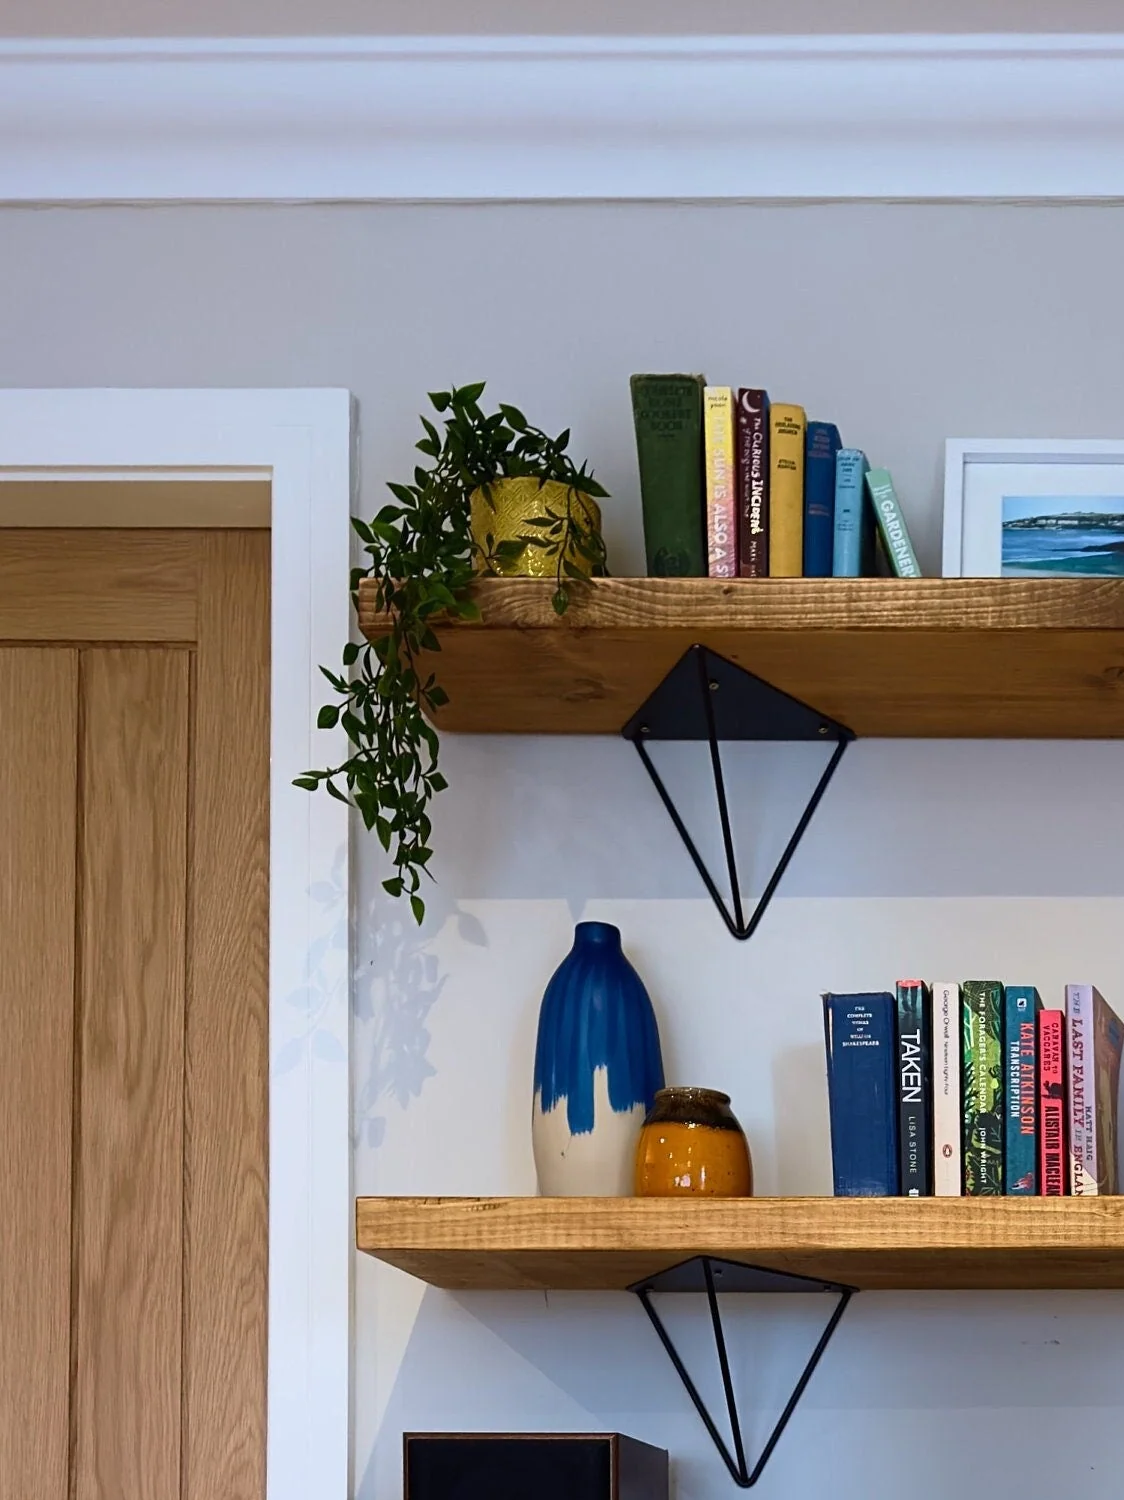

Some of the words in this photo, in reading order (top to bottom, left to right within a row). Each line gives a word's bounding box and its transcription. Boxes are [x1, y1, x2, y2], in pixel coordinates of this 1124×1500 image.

[713, 449, 726, 480] SUN
[714, 485, 726, 498] IS
[714, 504, 727, 544] ALSO
[715, 548, 727, 559] A
[1020, 1023, 1034, 1056] KATE
[1072, 1018, 1083, 1060] LAST
[901, 1029, 921, 1102] TAKEN
[1010, 1041, 1019, 1118] TRANSCRIPTION
[1021, 1064, 1034, 1135] ATKINSON
[1072, 1065, 1084, 1128] FAMILY
[1044, 1106, 1059, 1149] ALISTAIR
